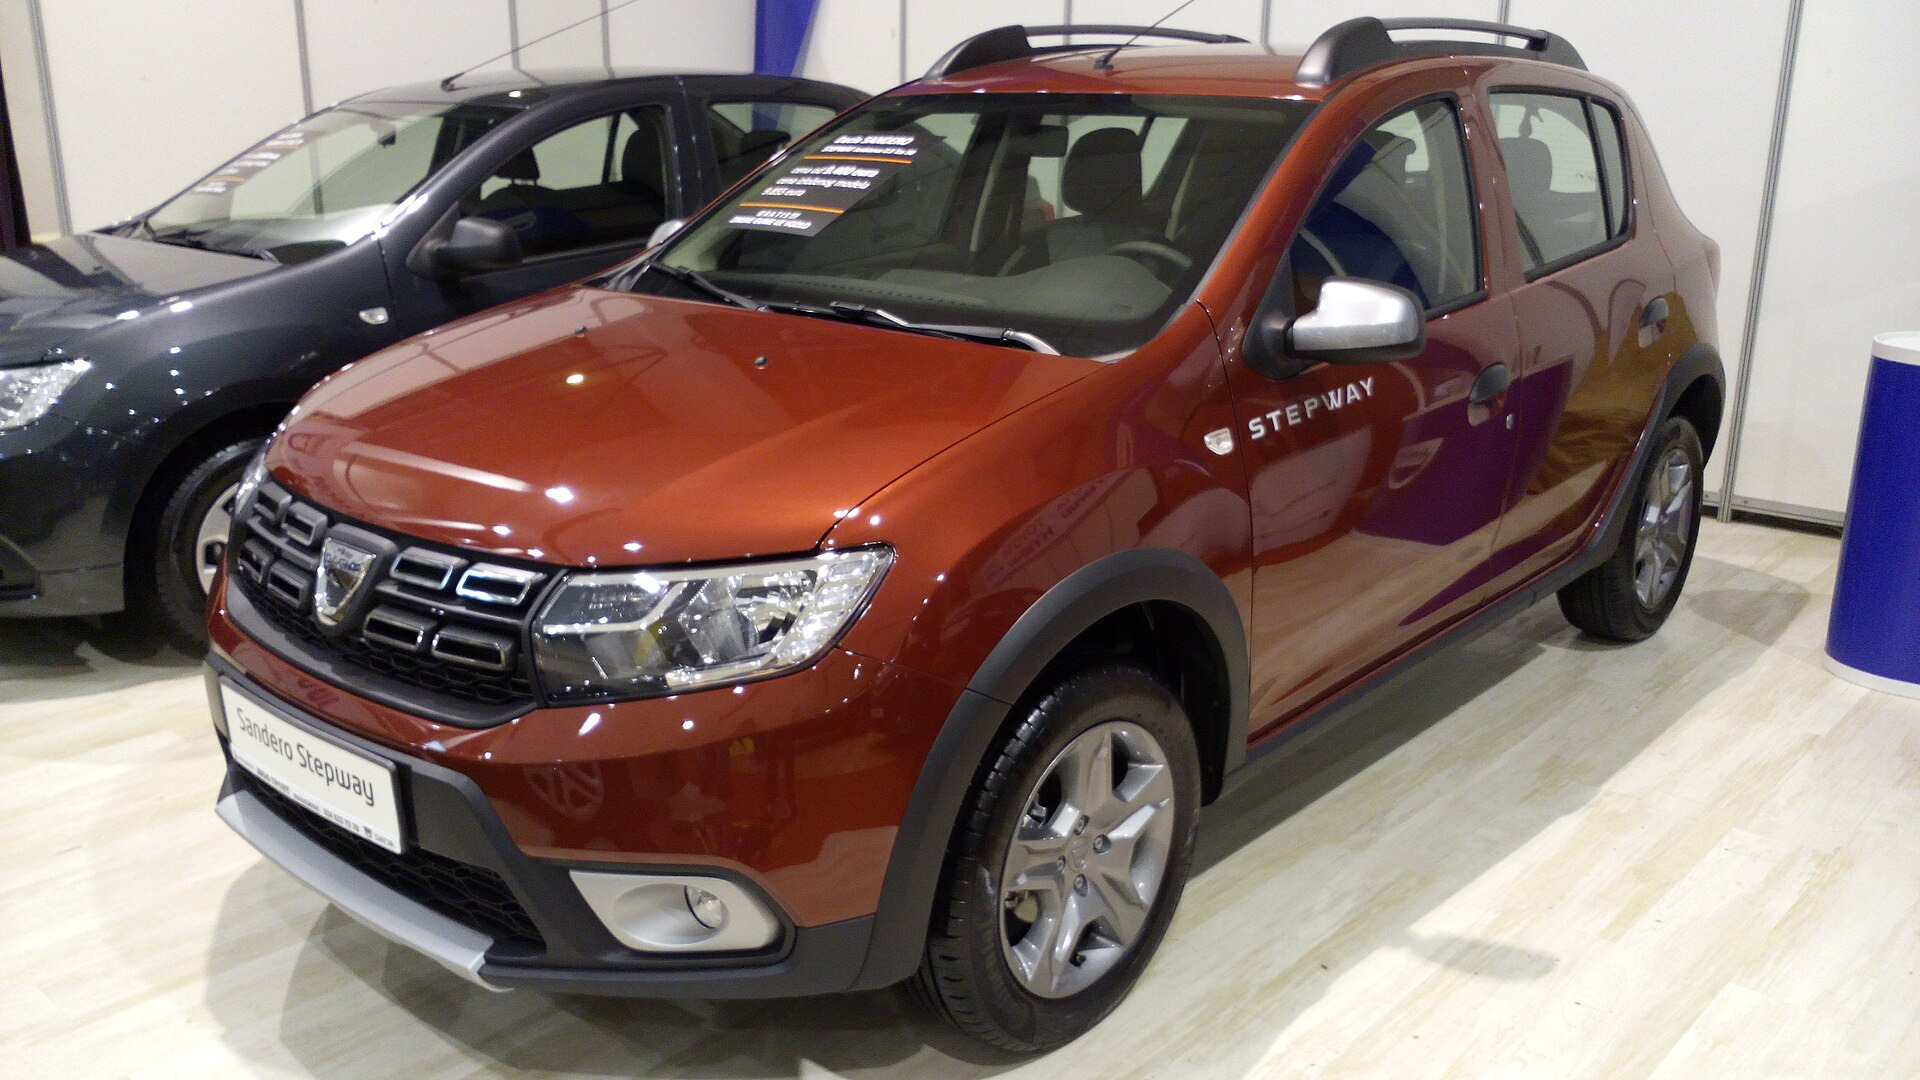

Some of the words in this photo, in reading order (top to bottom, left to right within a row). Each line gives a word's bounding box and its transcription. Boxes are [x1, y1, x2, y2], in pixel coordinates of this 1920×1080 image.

[860, 136, 915, 146] SANDERO
[851, 169, 880, 178] euro
[783, 189, 807, 197] euro
[1248, 376, 1373, 440] STEPWAY
[236, 707, 293, 760] Sandero
[296, 743, 375, 806] Stepway
